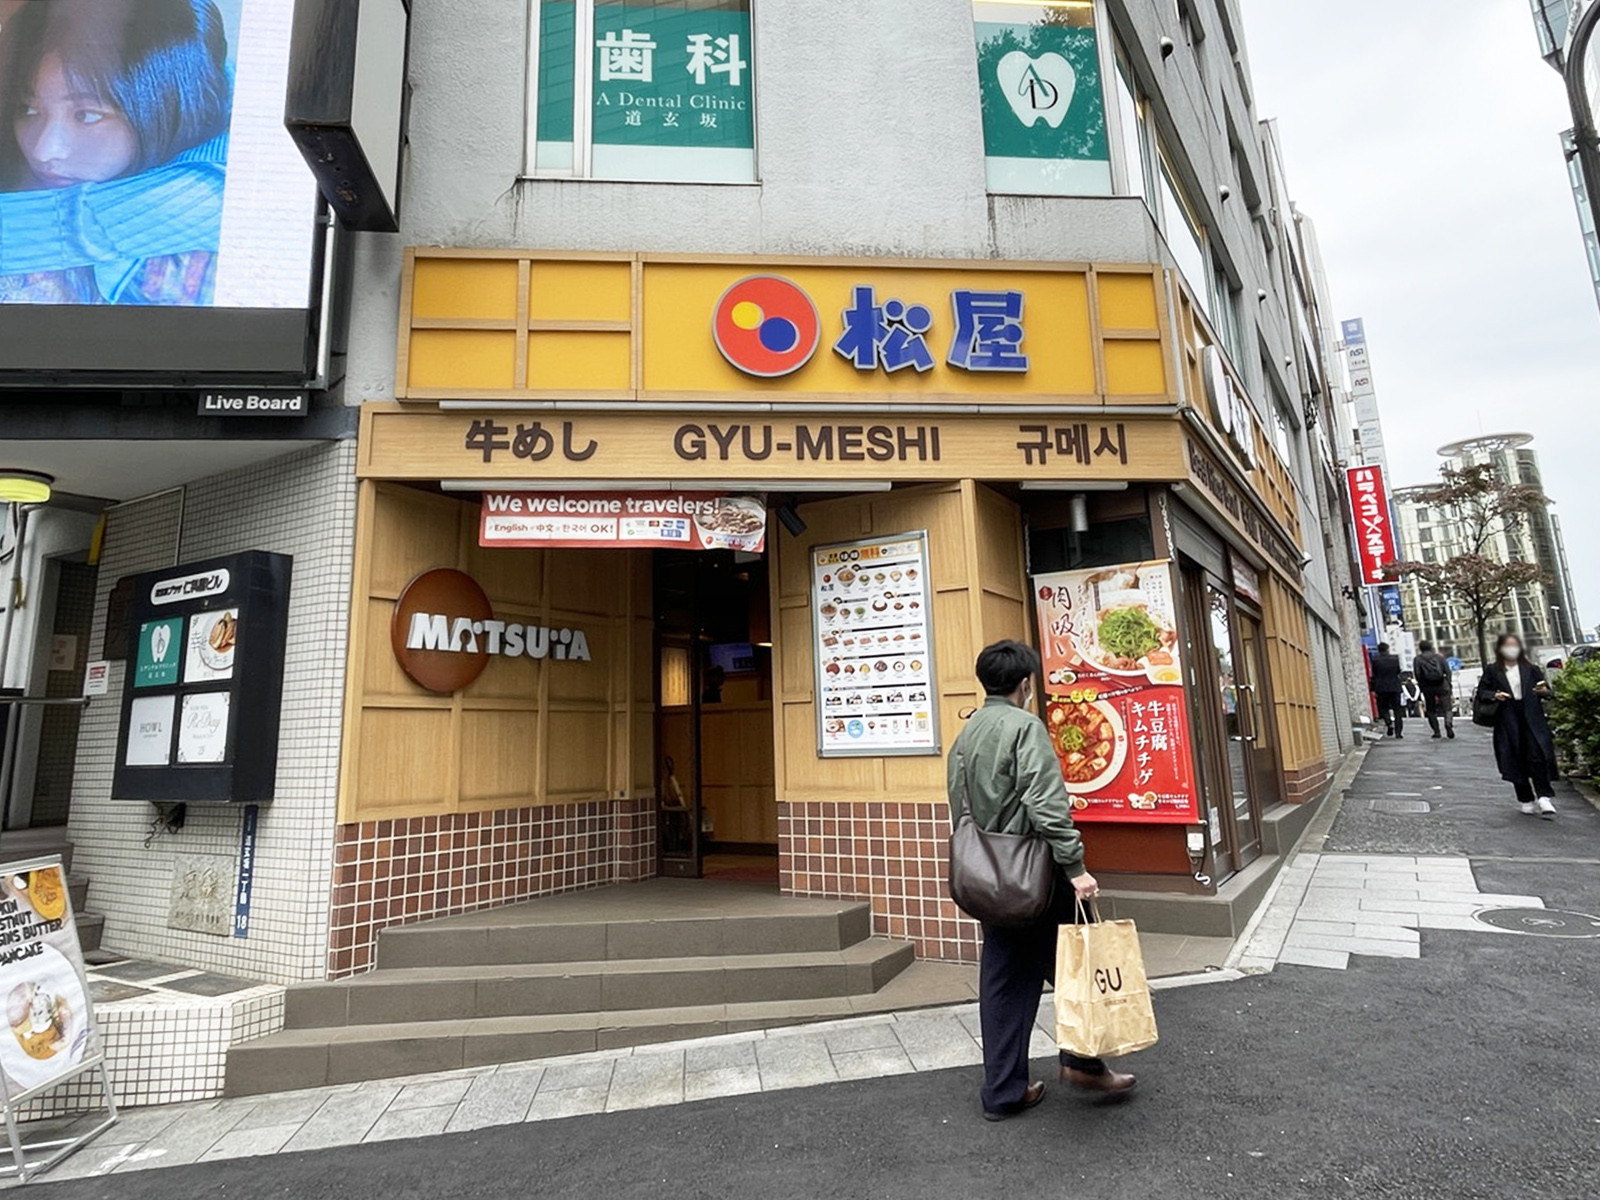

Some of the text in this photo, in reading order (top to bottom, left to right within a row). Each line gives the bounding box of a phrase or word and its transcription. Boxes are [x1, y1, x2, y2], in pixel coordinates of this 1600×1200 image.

[596, 29, 748, 86] 歯科
[596, 92, 746, 111] A Dental Clinic
[624, 110, 718, 128] 道玄坂
[833, 285, 1030, 373] 松屋
[205, 395, 302, 411] Live Board
[465, 419, 598, 463] 牛めし
[674, 423, 941, 461] GYU-MESHI
[1016, 423, 1128, 465] 규메시
[487, 494, 720, 515] We welcome travelers!
[494, 523, 614, 534] English 中文 한국어 OK!
[407, 612, 592, 661] MATSUYA
[1051, 586, 1080, 655] 肉吸い
[140, 721, 162, 733] HOWL
[1146, 700, 1169, 751] 牛豆腐
[1131, 701, 1154, 786] キムチチゲ
[22, 917, 63, 940] BUTTER
[236, 914, 248, 930] 18
[1094, 966, 1123, 995] GU
